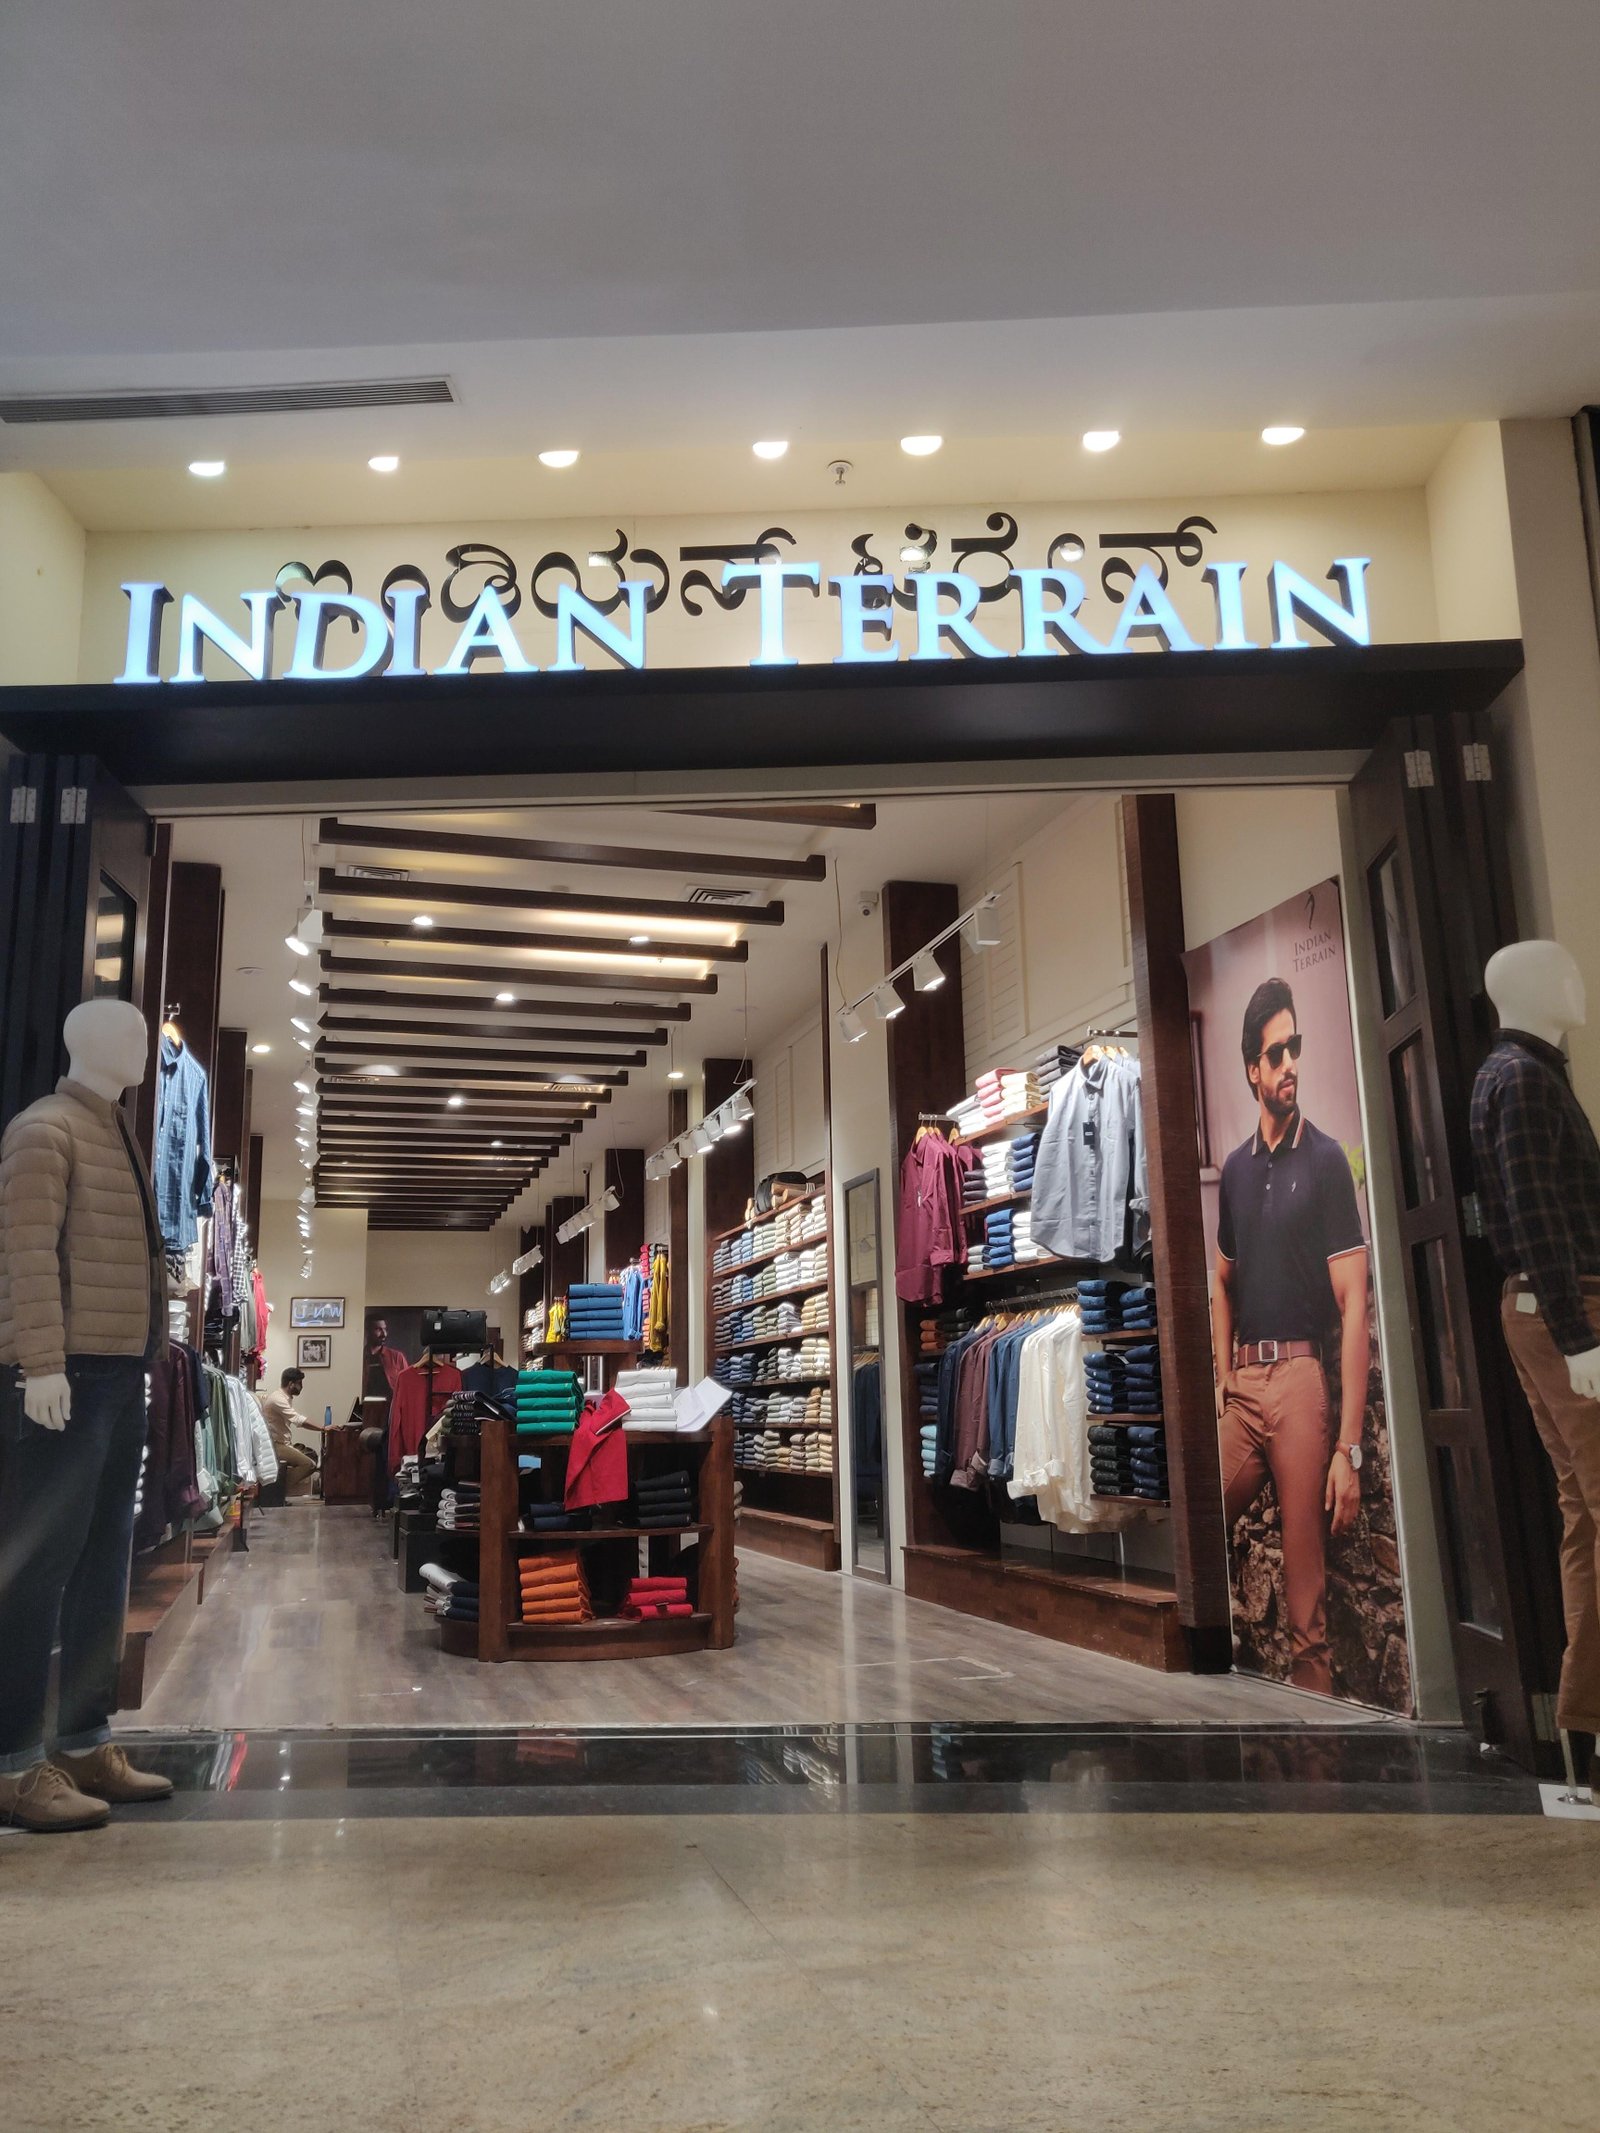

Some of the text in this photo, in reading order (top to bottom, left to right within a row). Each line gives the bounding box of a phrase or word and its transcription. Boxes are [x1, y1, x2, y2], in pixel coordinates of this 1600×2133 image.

[113, 557, 1371, 685] INDIAN TERRAIN
[1294, 931, 1331, 956] INDIAN
[1293, 944, 1336, 972] TERRAIN
